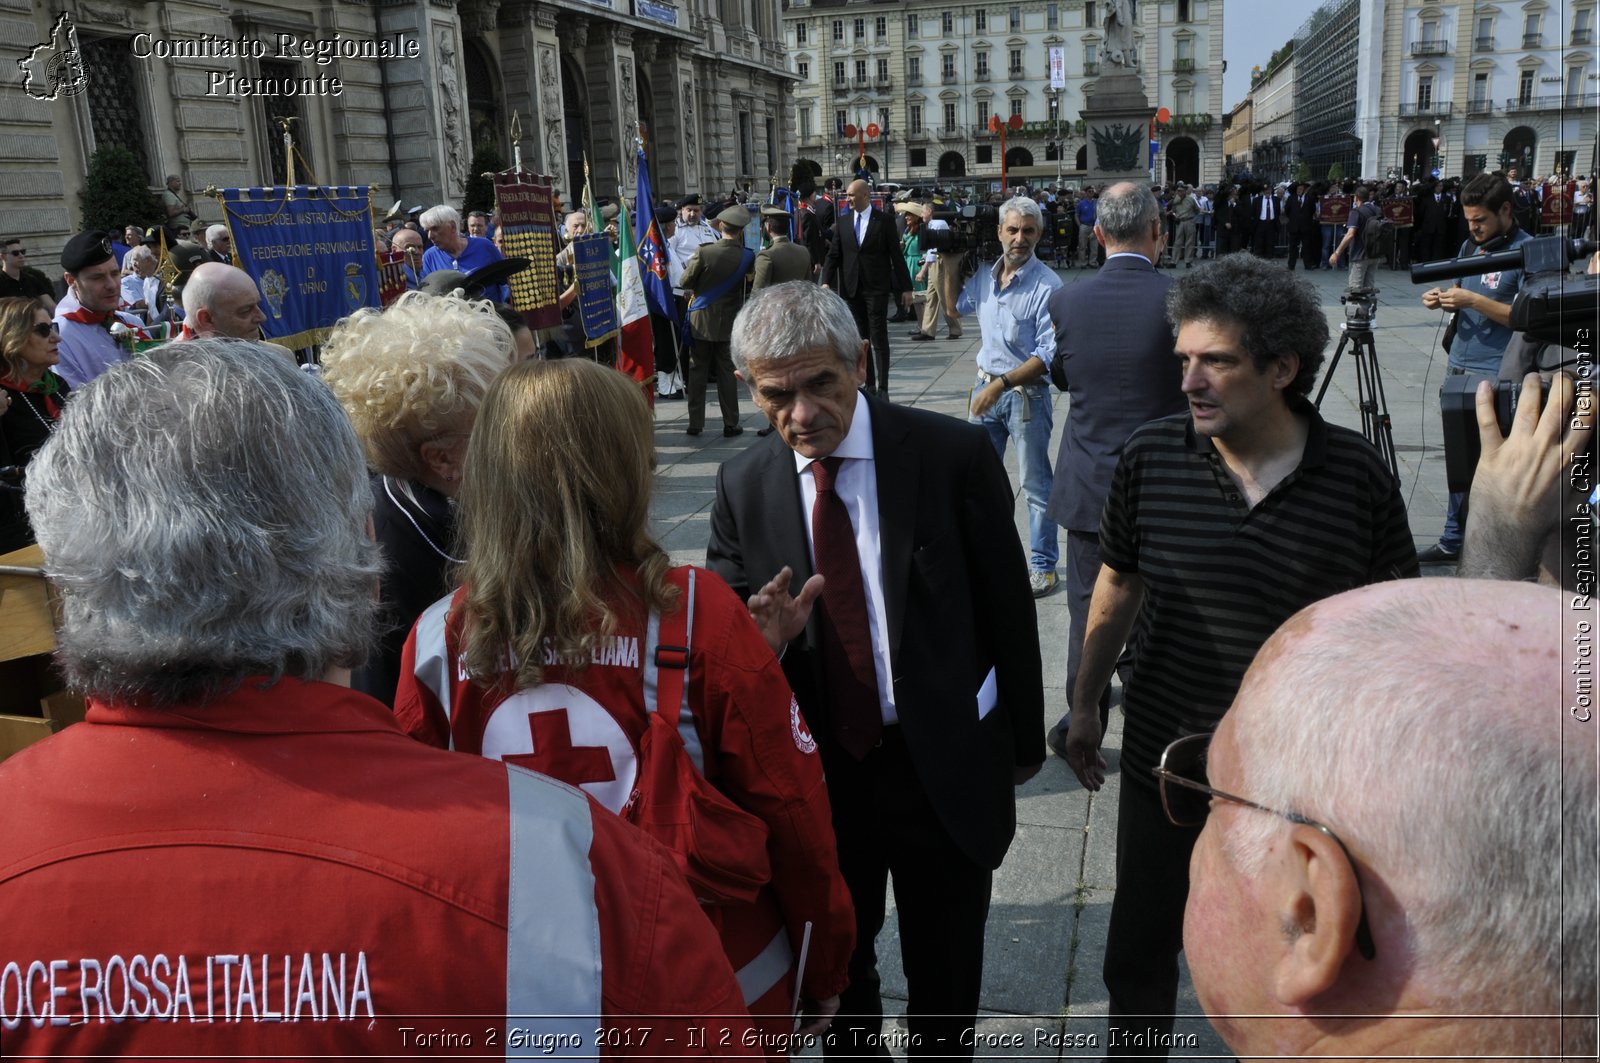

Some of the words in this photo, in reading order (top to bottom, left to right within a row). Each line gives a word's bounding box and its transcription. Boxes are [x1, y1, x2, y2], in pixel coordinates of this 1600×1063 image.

[314, 239, 367, 255] PROVINCALE
[298, 281, 327, 294] TORNO
[80, 954, 195, 1025] ROSSA
[207, 951, 375, 1024] ITALIANA
